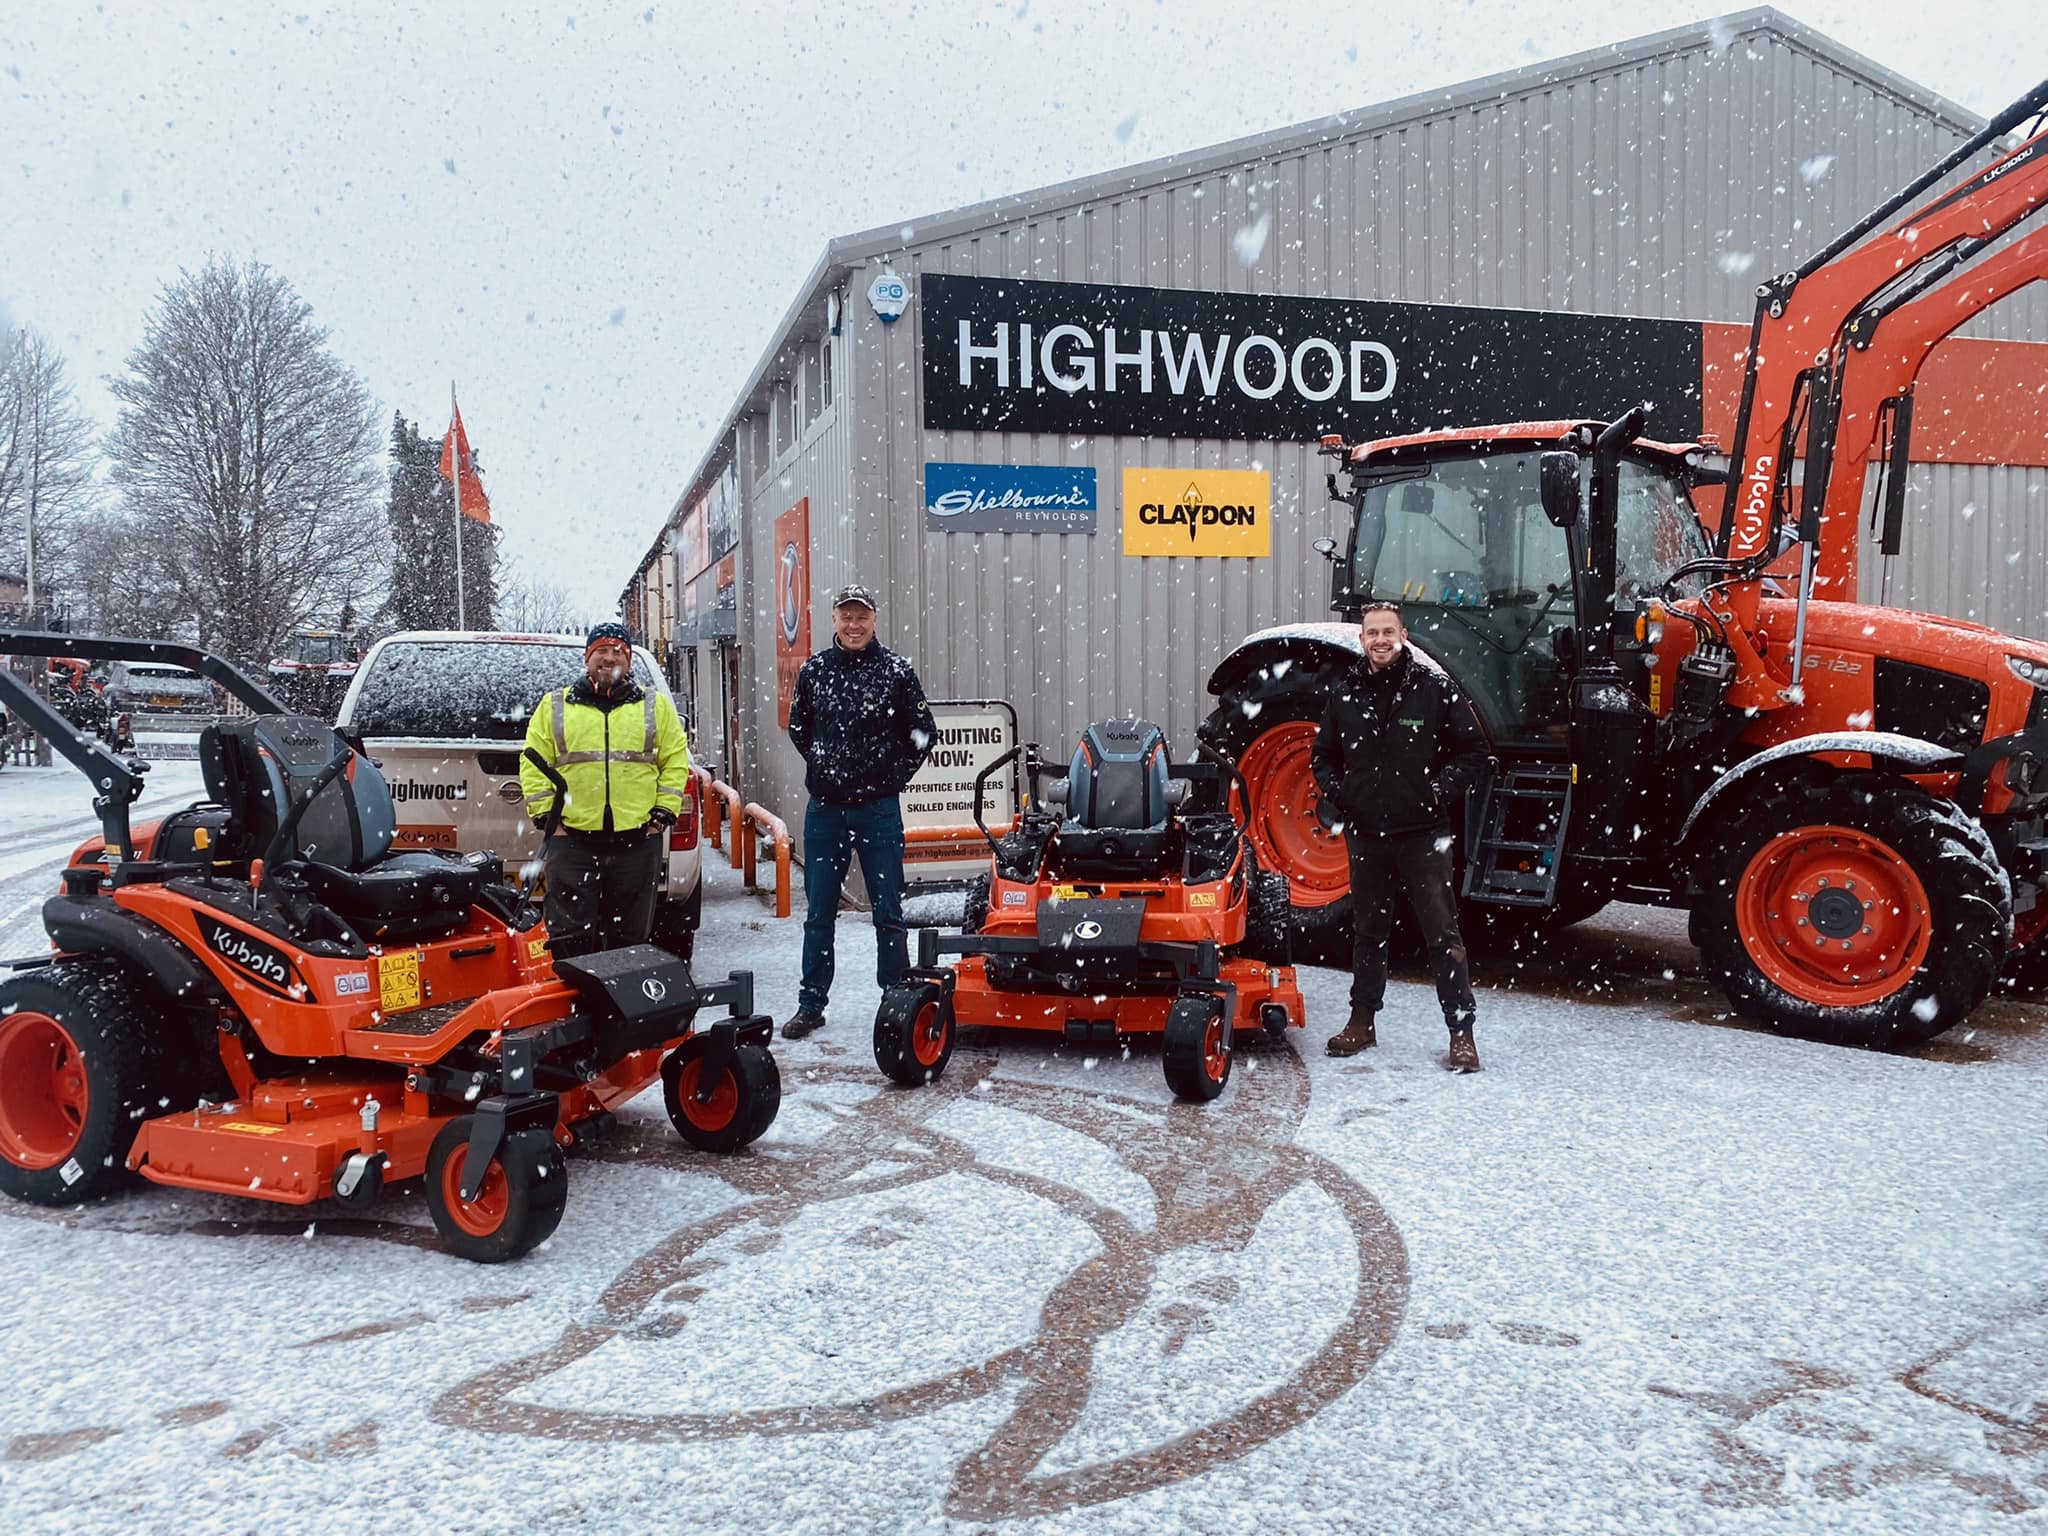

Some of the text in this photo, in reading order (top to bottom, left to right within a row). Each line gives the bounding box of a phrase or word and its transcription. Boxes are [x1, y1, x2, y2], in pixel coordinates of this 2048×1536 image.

[958, 319, 1398, 402] HIGHWOOD
[928, 488, 1089, 517] Shelbourne
[1737, 456, 1773, 550] Kubota
[1015, 512, 1086, 521] REYNOLDS
[1139, 503, 1255, 541] CLAYDON
[1802, 654, 1863, 675] 6-122
[937, 727, 1001, 745] RUITING
[1106, 732, 1139, 741] Kubota
[928, 750, 974, 768] NOW:
[387, 778, 467, 802] ighwood
[904, 781, 1004, 794] PPRENTICE ENGIEERS
[907, 800, 996, 813] SKILLED ENGINRS
[213, 927, 286, 982] Kubota
